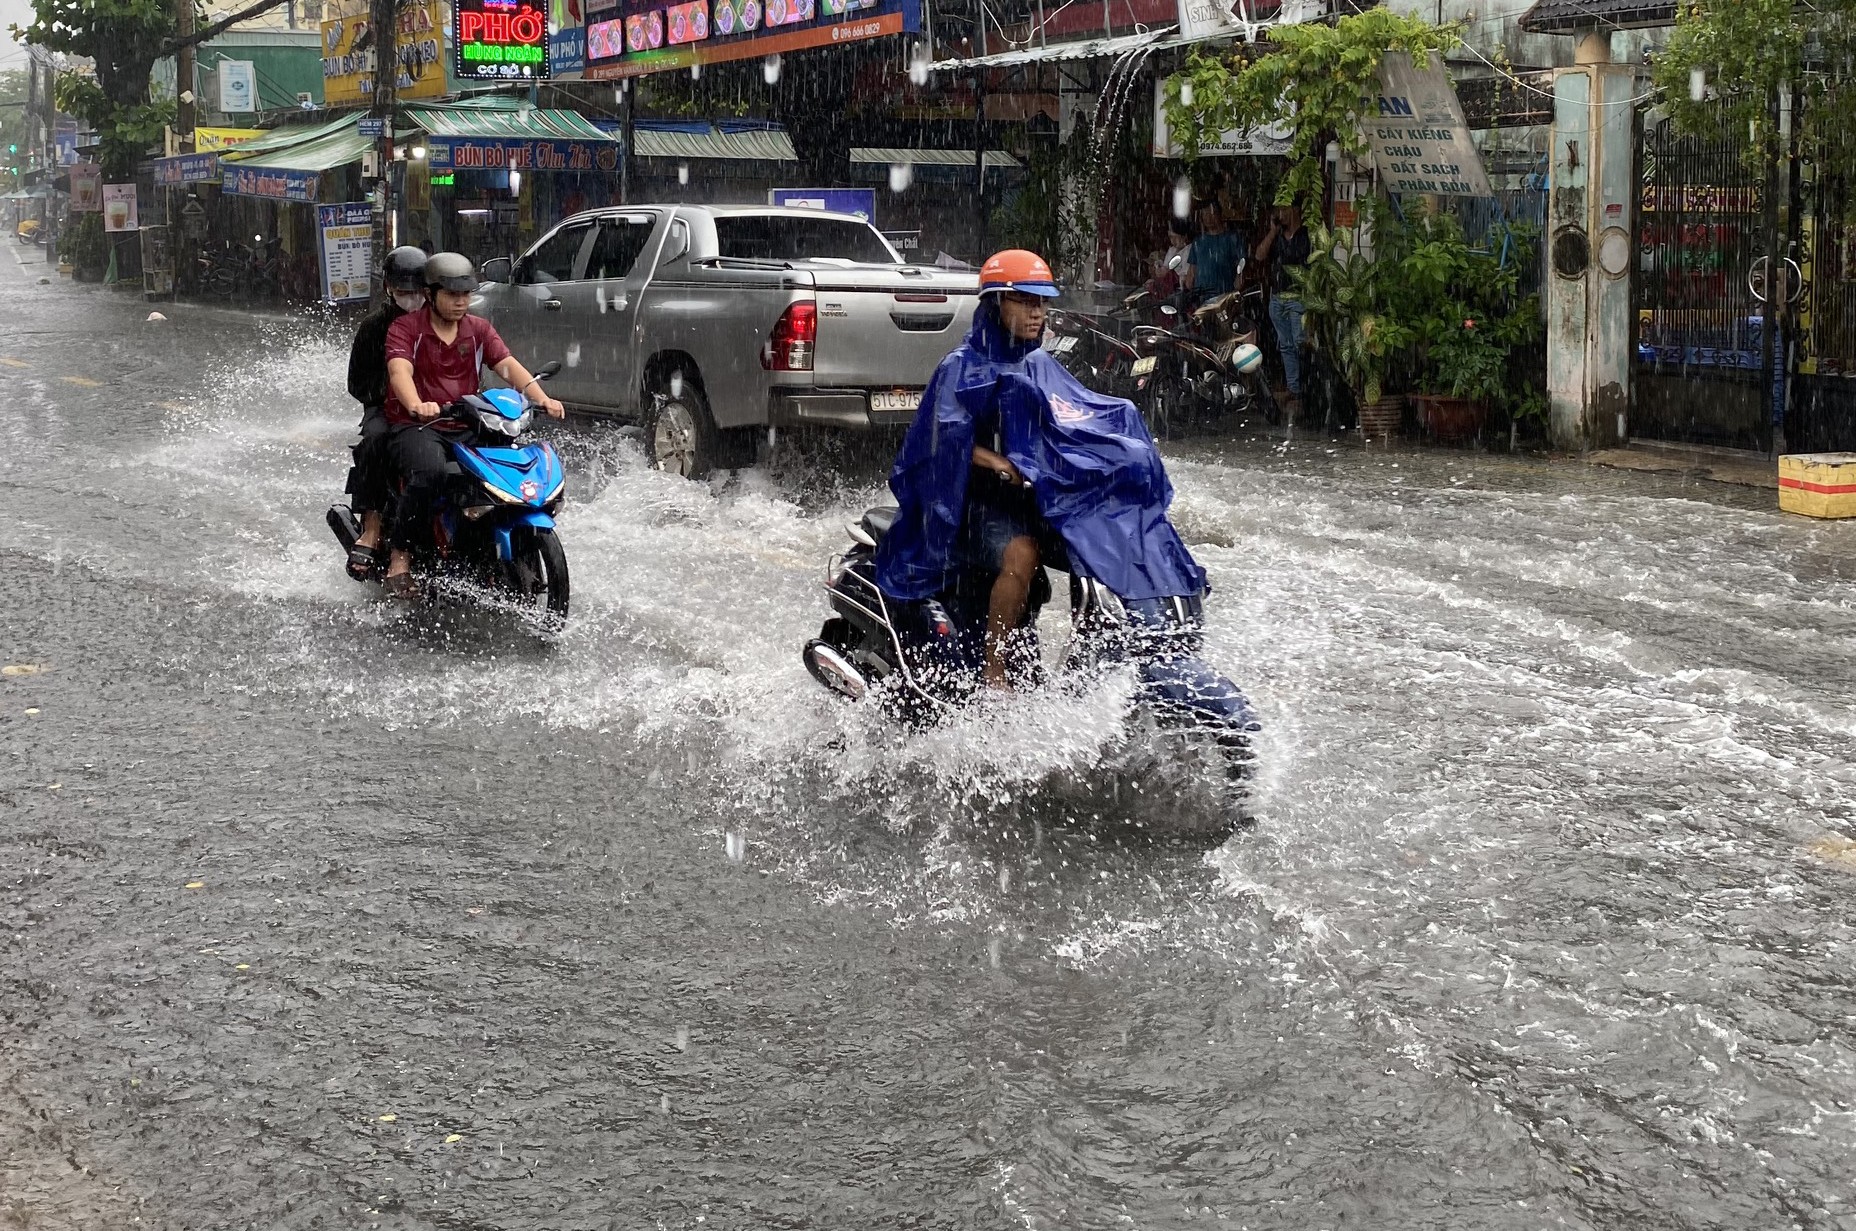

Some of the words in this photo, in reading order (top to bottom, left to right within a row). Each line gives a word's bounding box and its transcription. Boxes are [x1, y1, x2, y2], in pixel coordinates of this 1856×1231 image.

[461, 5, 542, 42] PHỞ
[852, 25, 863, 37] 666
[463, 41, 502, 60] HÙNG
[505, 44, 542, 61] NGÂN
[1377, 127, 1403, 140] CÂY
[1407, 125, 1453, 140] KIỂNG
[454, 143, 484, 167] BÚN
[485, 143, 504, 167] BÒ
[505, 142, 533, 168] HUẾ
[1384, 145, 1422, 158] CHẬU
[1391, 160, 1417, 173] ĐẤT
[1421, 163, 1460, 176] SẠCH
[1398, 178, 1438, 192] PHÂN
[872, 392, 921, 408] 51C-975
